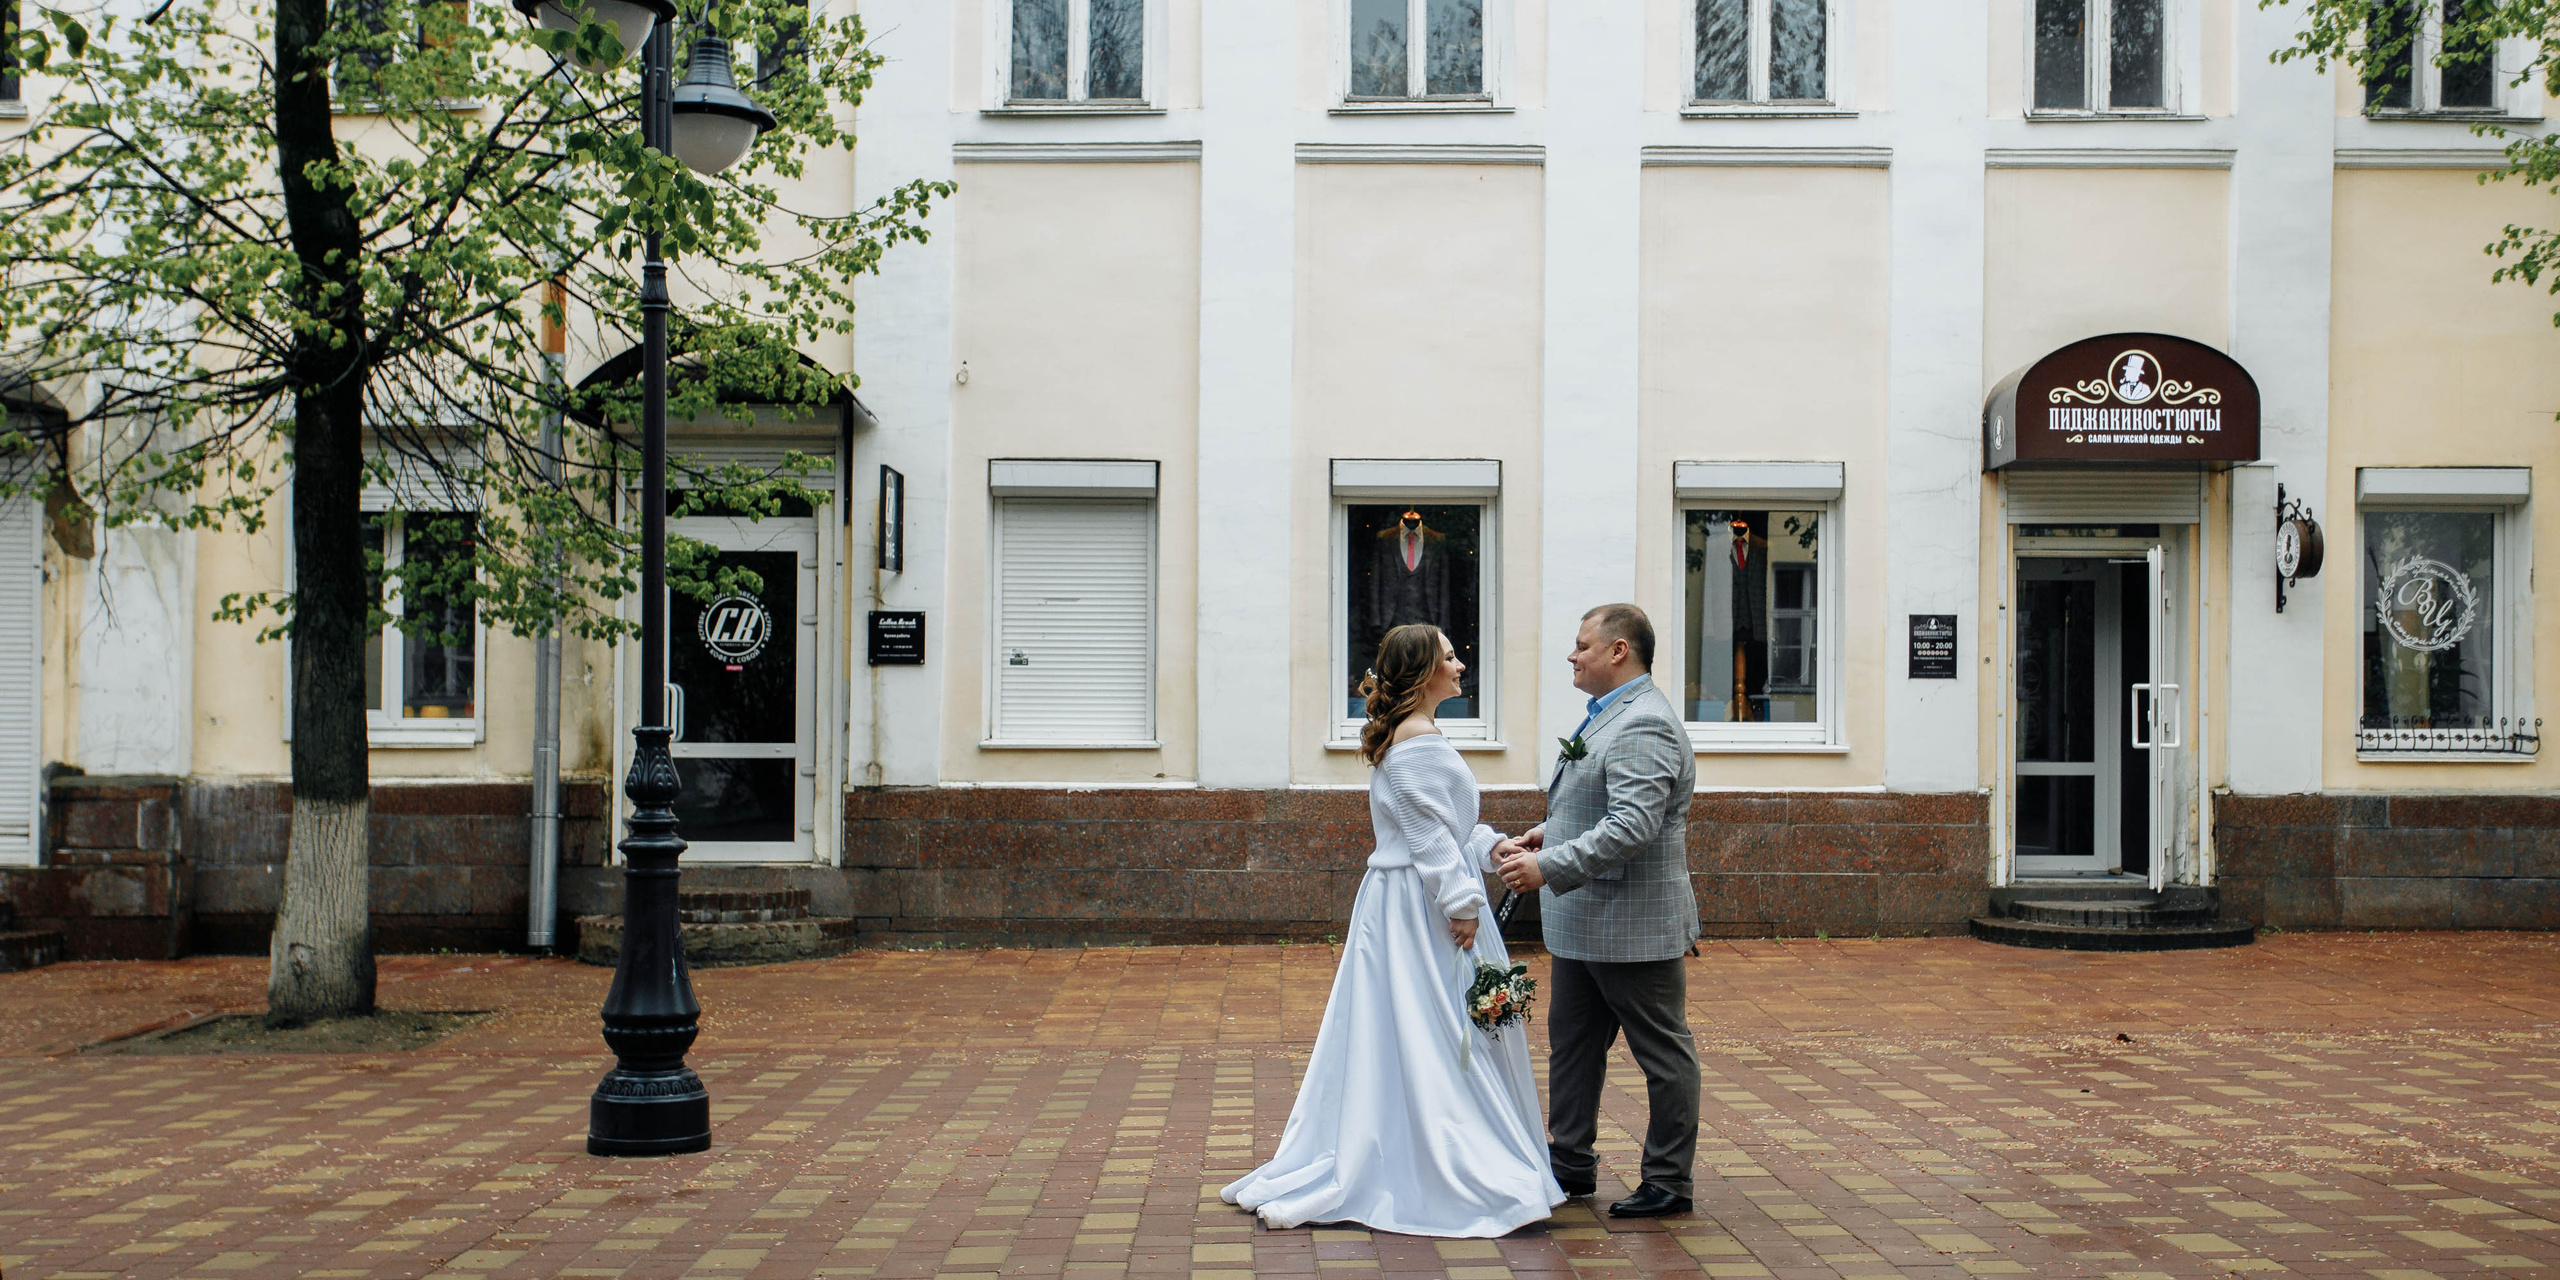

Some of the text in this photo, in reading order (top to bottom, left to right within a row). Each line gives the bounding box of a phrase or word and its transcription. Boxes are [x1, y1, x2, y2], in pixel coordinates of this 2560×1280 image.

[2049, 407, 2221, 431] ПИДЖАКИКОСТЮМЫ
[2088, 433, 2182, 444] САЛОН МУЖСКОЙ ОДЕЖДЫ
[709, 649, 728, 662] КОФЕ
[737, 649, 761, 664] СОБОЙ
